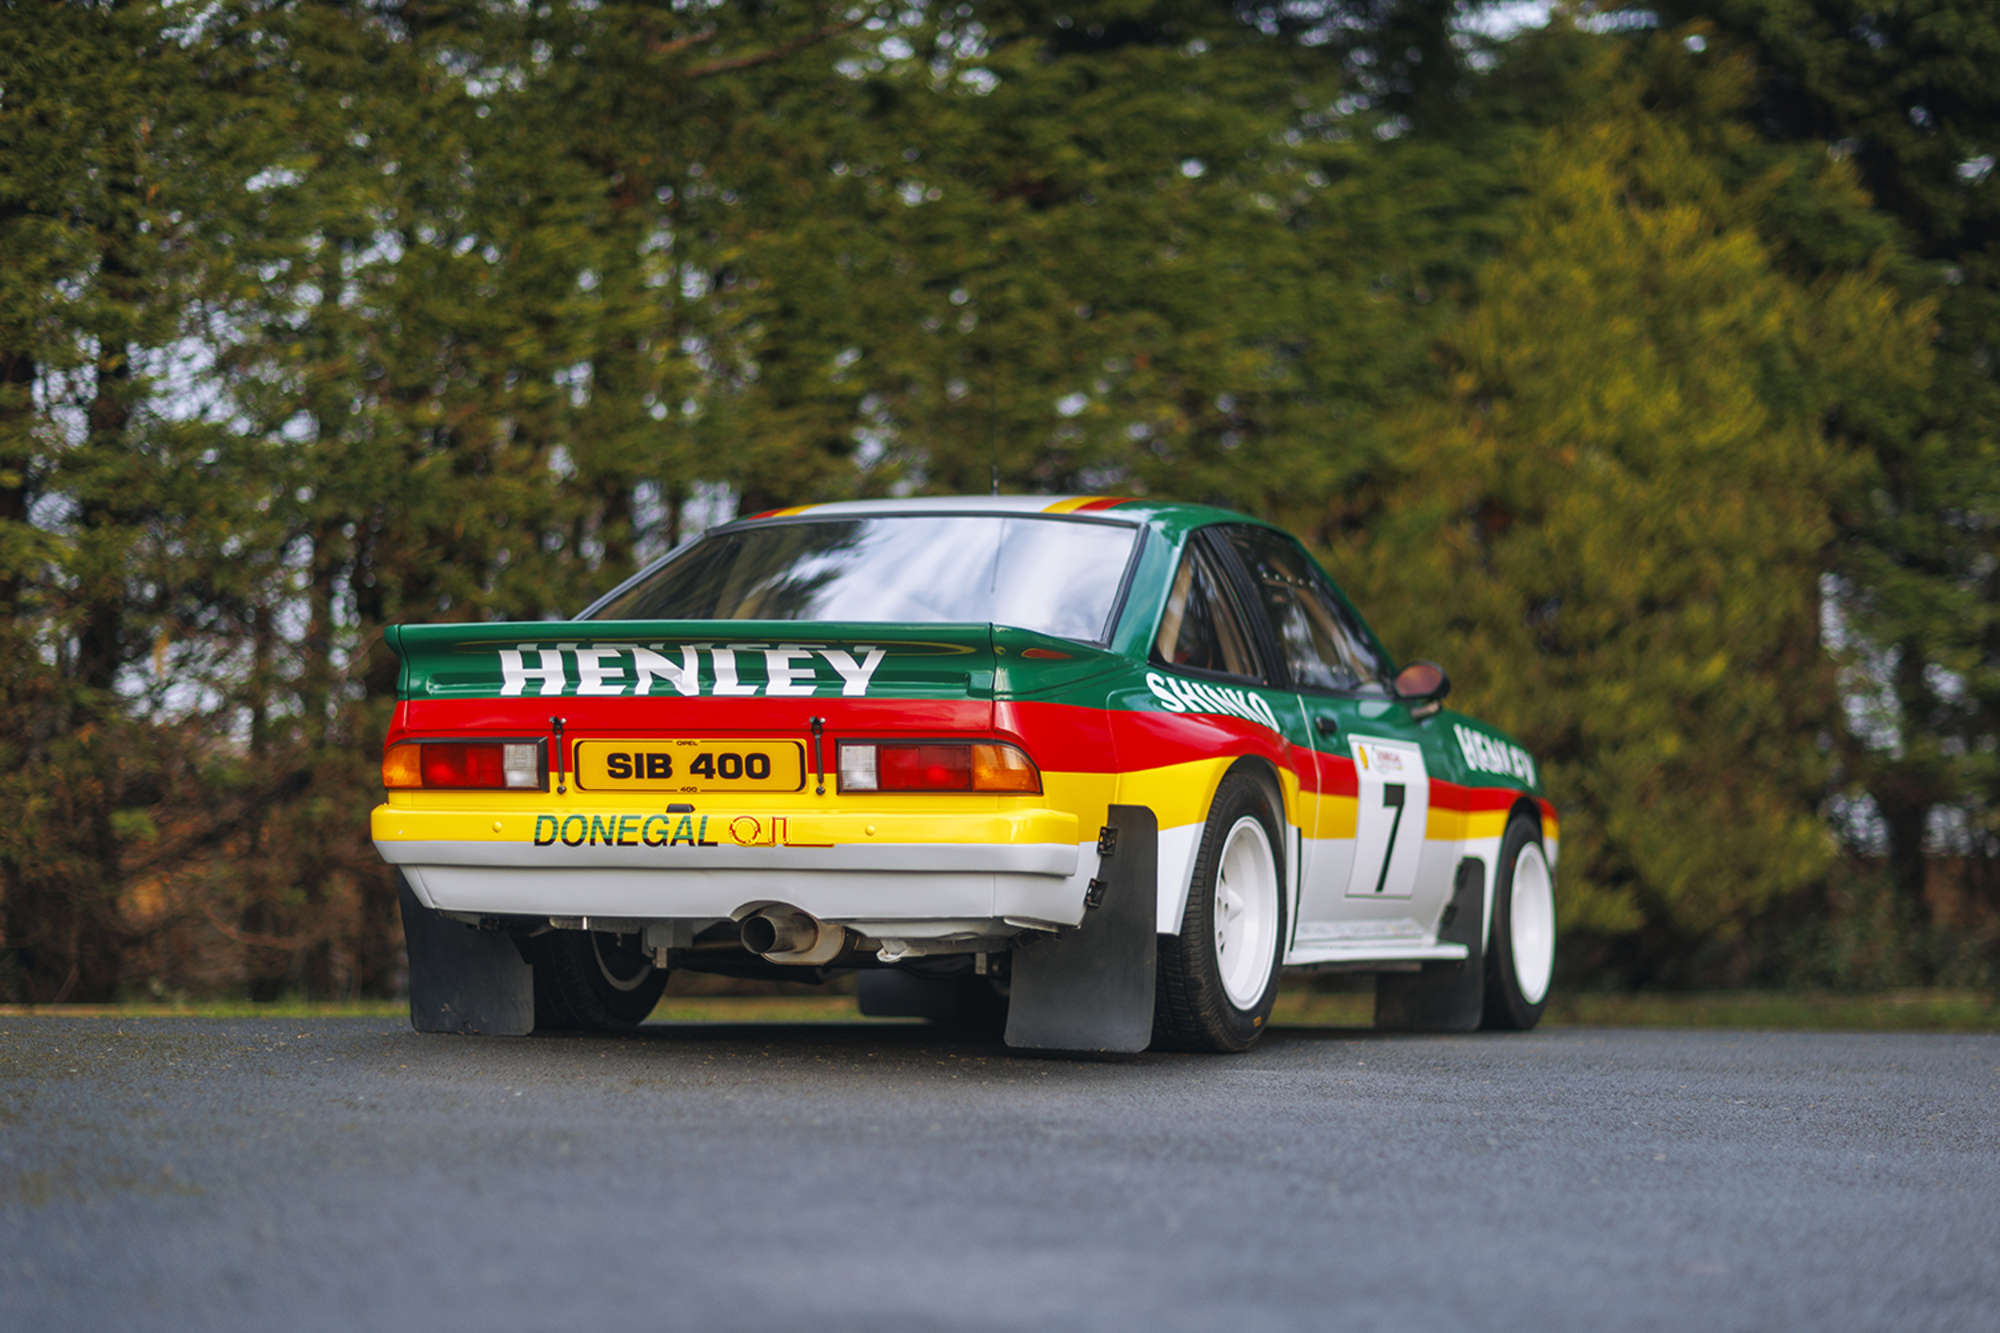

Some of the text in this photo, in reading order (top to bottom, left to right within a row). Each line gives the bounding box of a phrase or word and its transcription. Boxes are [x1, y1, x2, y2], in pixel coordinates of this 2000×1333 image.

[498, 645, 886, 697] HENLEY
[1146, 672, 1280, 733] SHINKO
[607, 752, 771, 780] SIB 400
[533, 814, 718, 847] DONEGAL
[1375, 782, 1406, 892] 7
